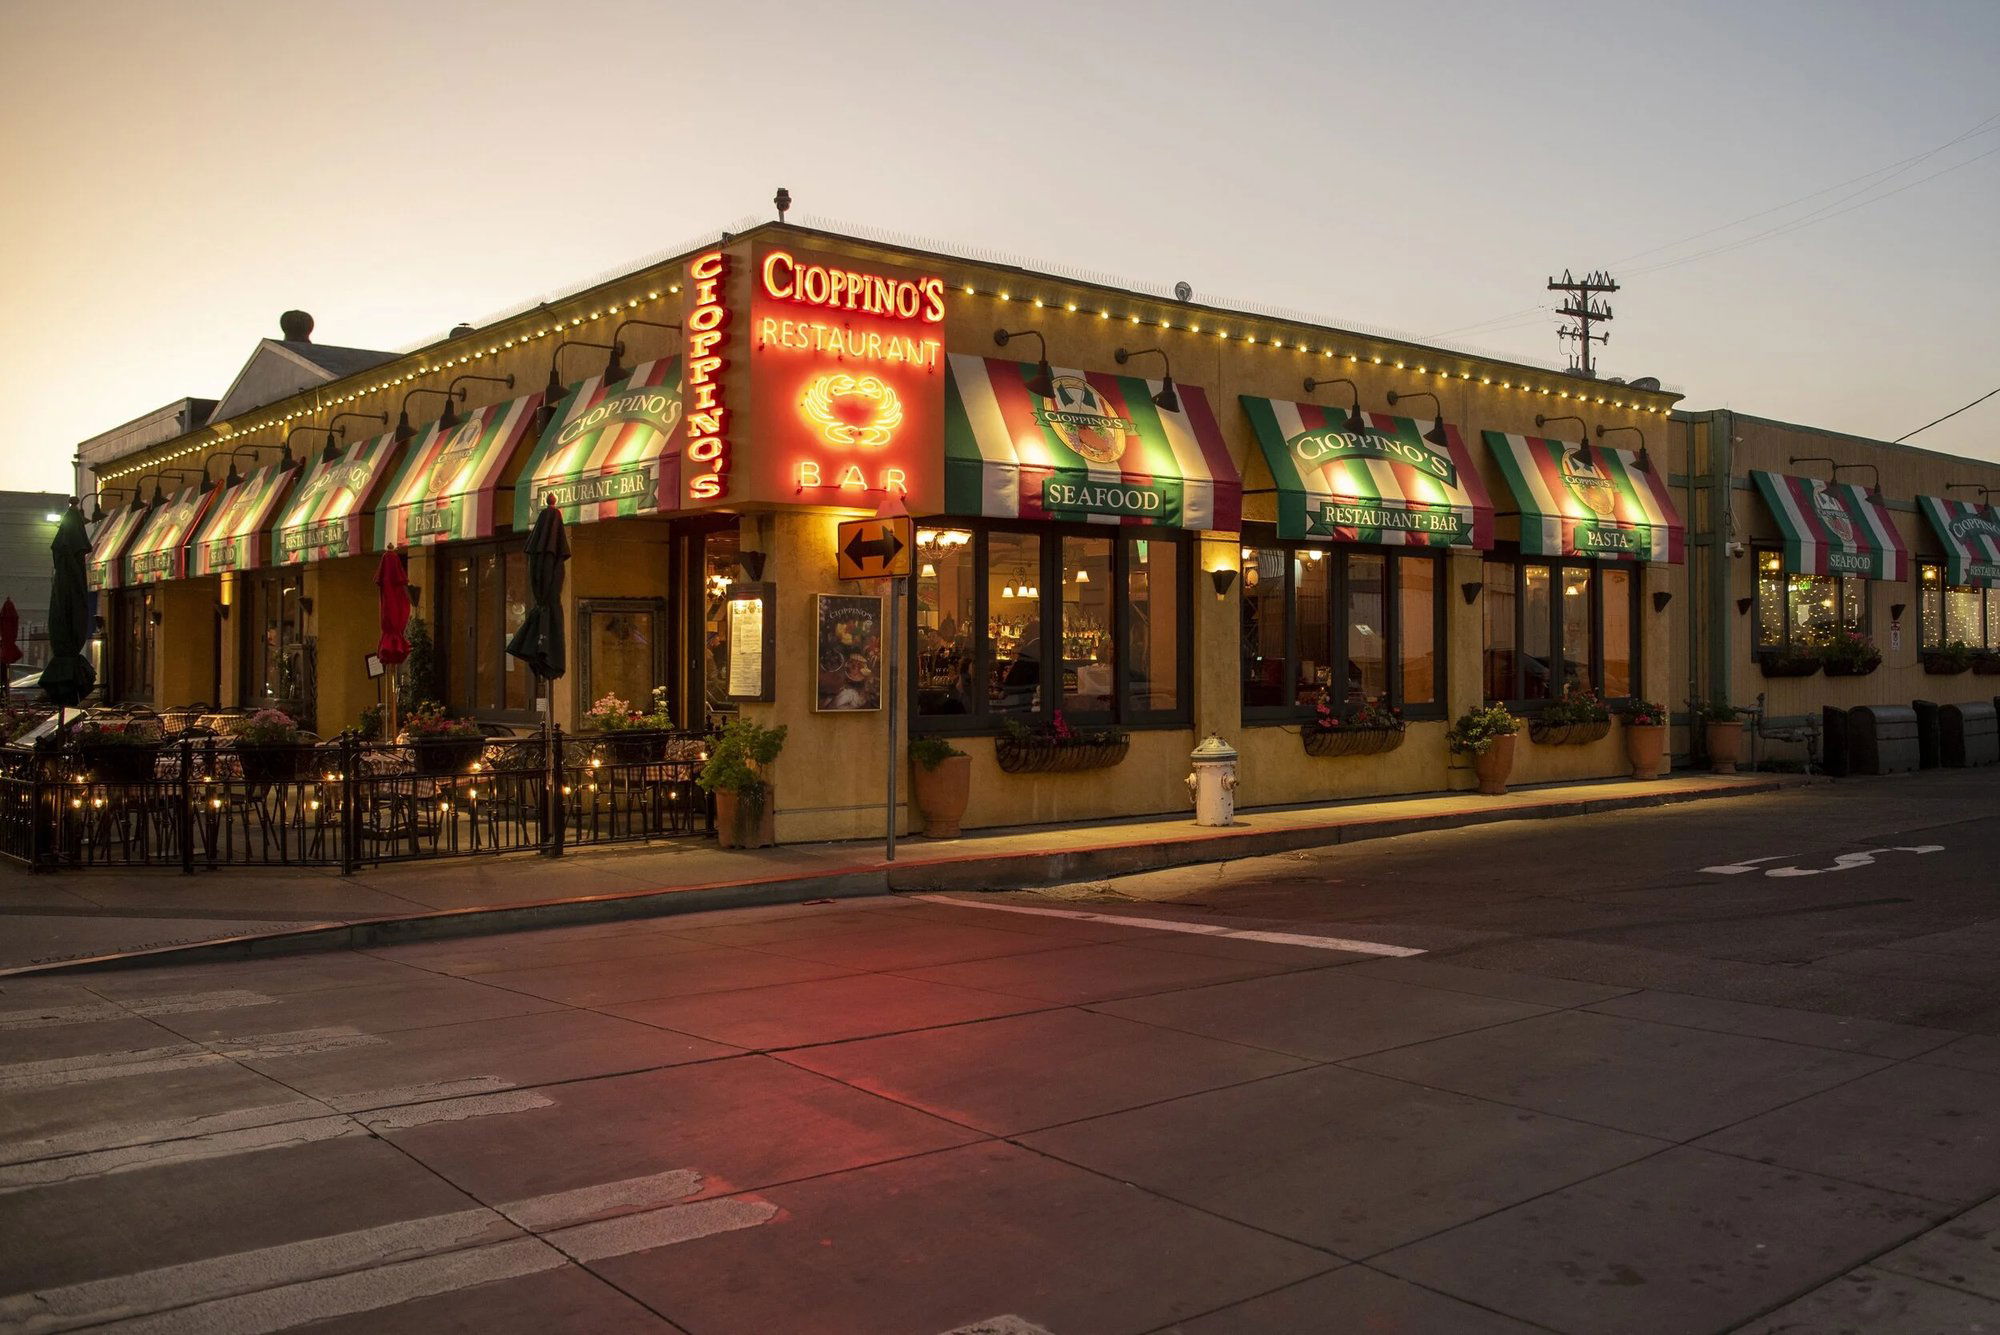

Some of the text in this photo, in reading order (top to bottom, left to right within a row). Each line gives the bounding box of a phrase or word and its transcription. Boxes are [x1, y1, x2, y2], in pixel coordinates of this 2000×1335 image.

[763, 252, 945, 322] CIOPPINO'S
[762, 318, 941, 366] RESTAURANT
[688, 252, 723, 499] CIOPPINO'S
[557, 394, 682, 445] CIOPPINO'S
[1045, 411, 1124, 429] CIOPPINO'S
[1296, 432, 1448, 477] CIOPPINO'S
[800, 461, 908, 494] BAR
[540, 480, 613, 507] RSTAURANT
[1049, 483, 1160, 510] SEAFOOD
[415, 513, 442, 532] PASTA
[1587, 530, 1629, 548] PASTA
[1830, 554, 1871, 570] SEAFOOD
[829, 606, 874, 620] CIOPPINO'S
